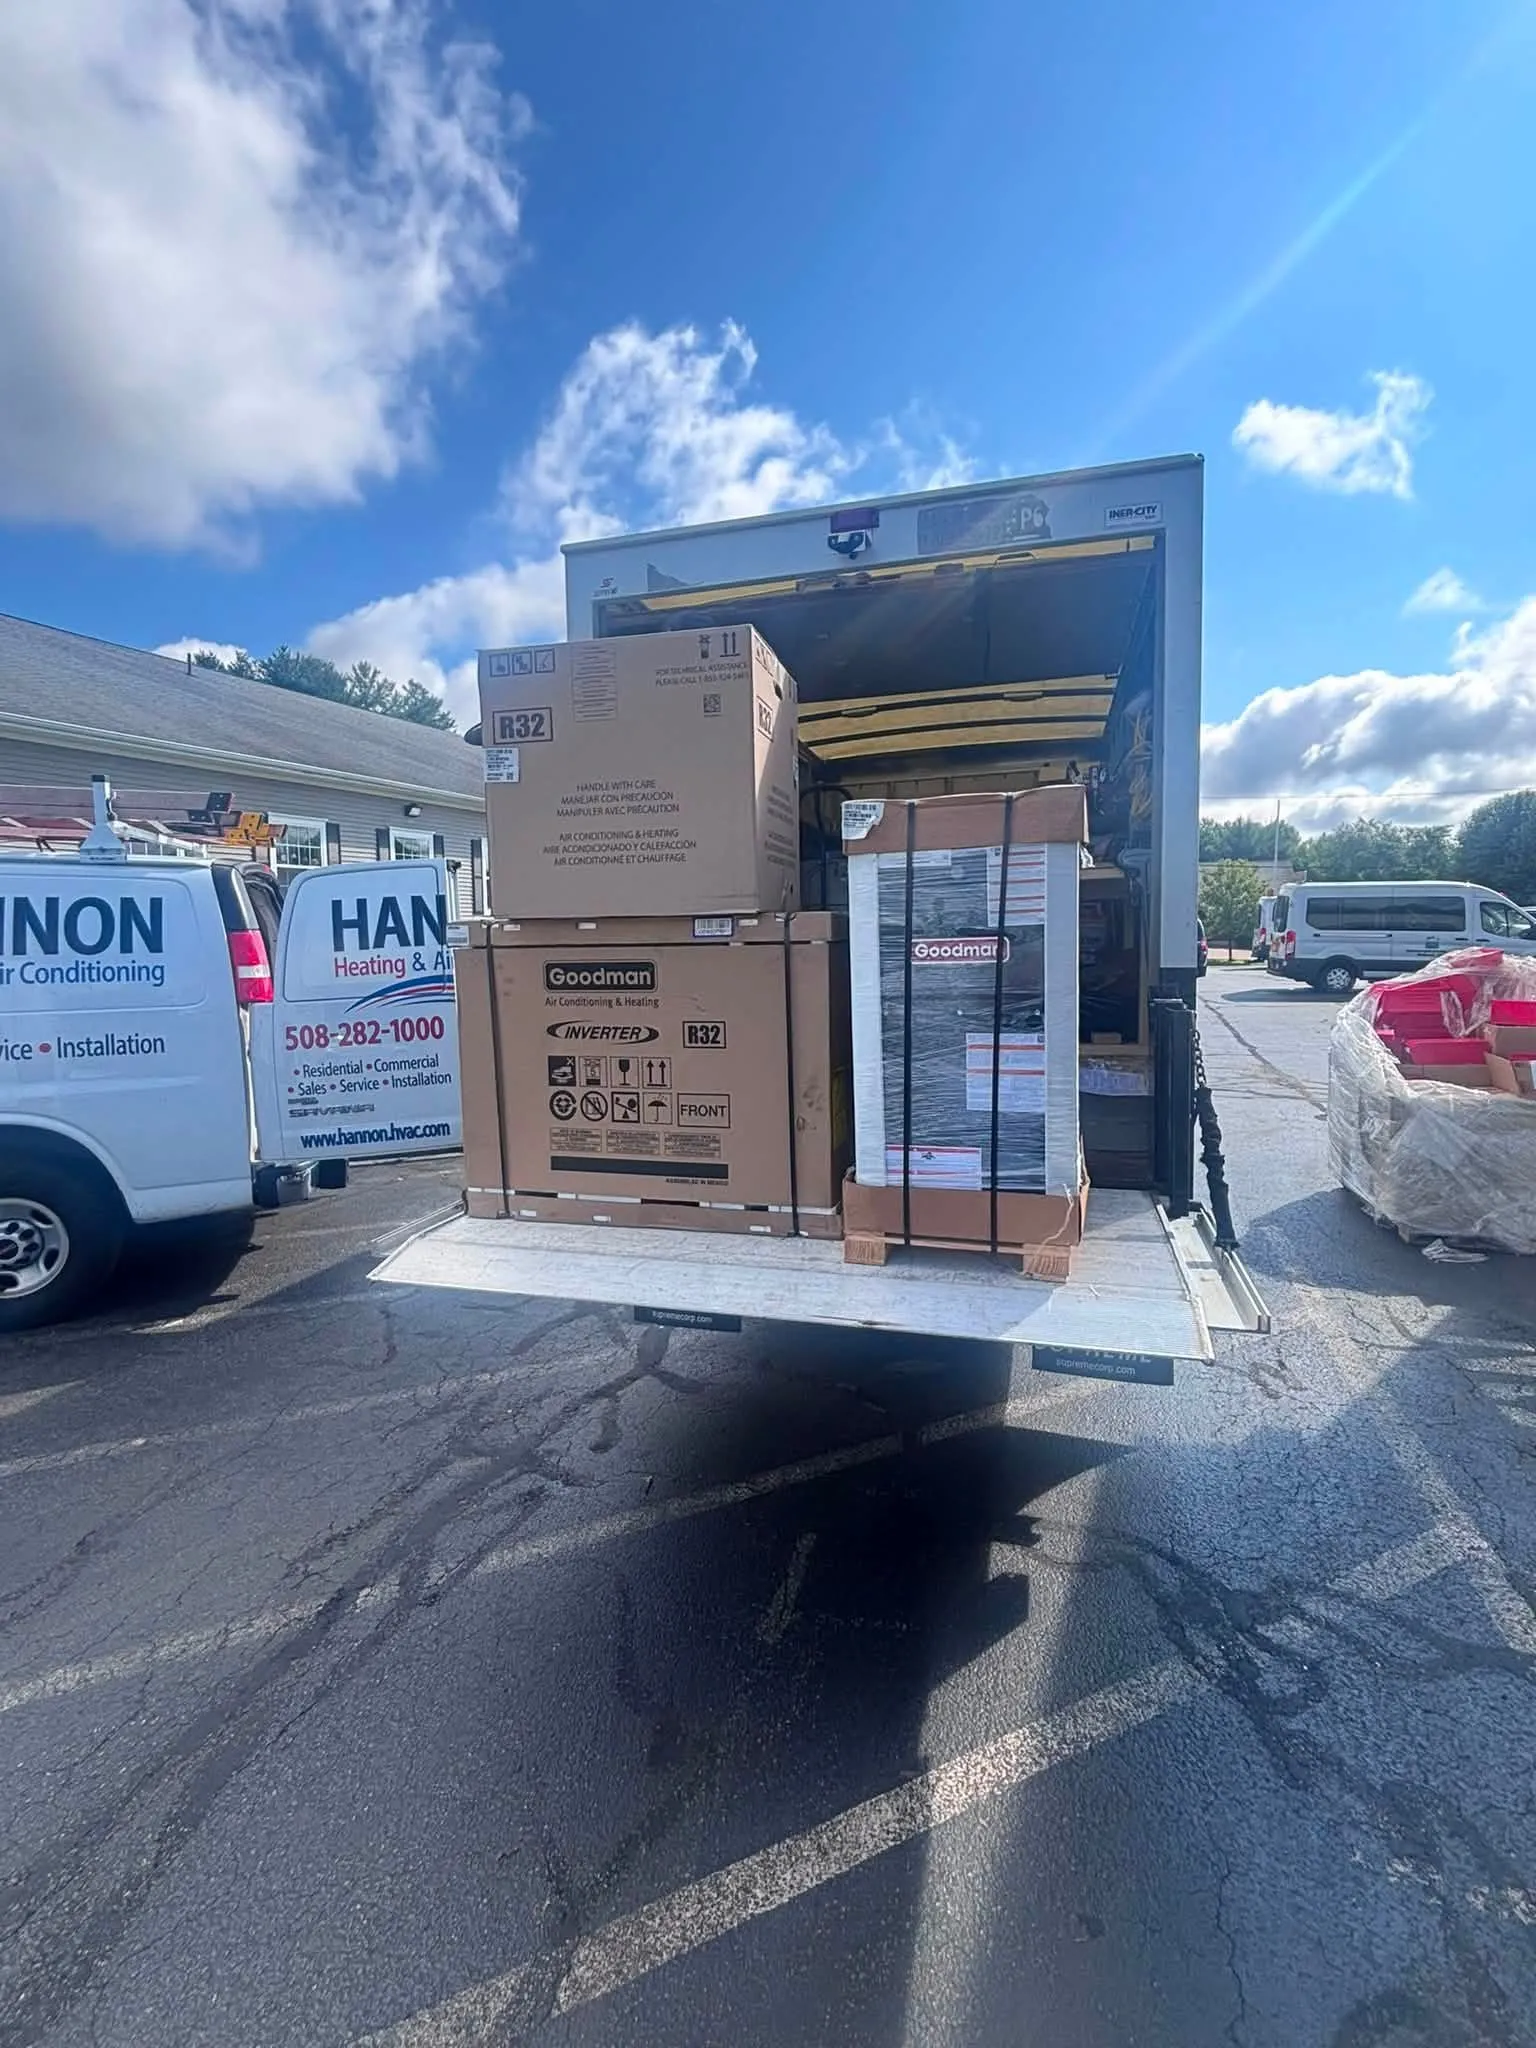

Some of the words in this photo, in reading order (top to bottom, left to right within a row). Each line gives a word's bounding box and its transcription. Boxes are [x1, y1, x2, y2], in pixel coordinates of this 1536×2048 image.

[500, 713, 545, 739] R32
[576, 781, 609, 792] HANDLE
[612, 780, 632, 790] WITH
[601, 793, 619, 803] CON
[605, 806, 625, 816] AVEC
[559, 832, 572, 841] AIR
[573, 830, 633, 841] CONDITIONING
[642, 828, 679, 838] HEATING
[554, 856, 568, 866] AIR
[626, 855, 636, 864] ET
[20, 959, 165, 987] Conditioning
[334, 954, 406, 978] Heating
[412, 952, 426, 971] &
[549, 967, 651, 985] Goodman
[545, 997, 557, 1006] Air
[559, 996, 613, 1009] Conditioning
[615, 997, 622, 1006] &
[625, 997, 659, 1009] Heating
[285, 1015, 444, 1051] 508-282-1000
[564, 1025, 642, 1040] INVERTER
[687, 1025, 721, 1045] R32
[57, 1033, 165, 1059] Installation
[303, 1060, 363, 1078] Residential
[374, 1053, 439, 1073] Commercial
[298, 1082, 327, 1096] Sales
[340, 1077, 380, 1093] Service
[391, 1071, 452, 1088] Installation
[680, 1103, 727, 1117] FRONT
